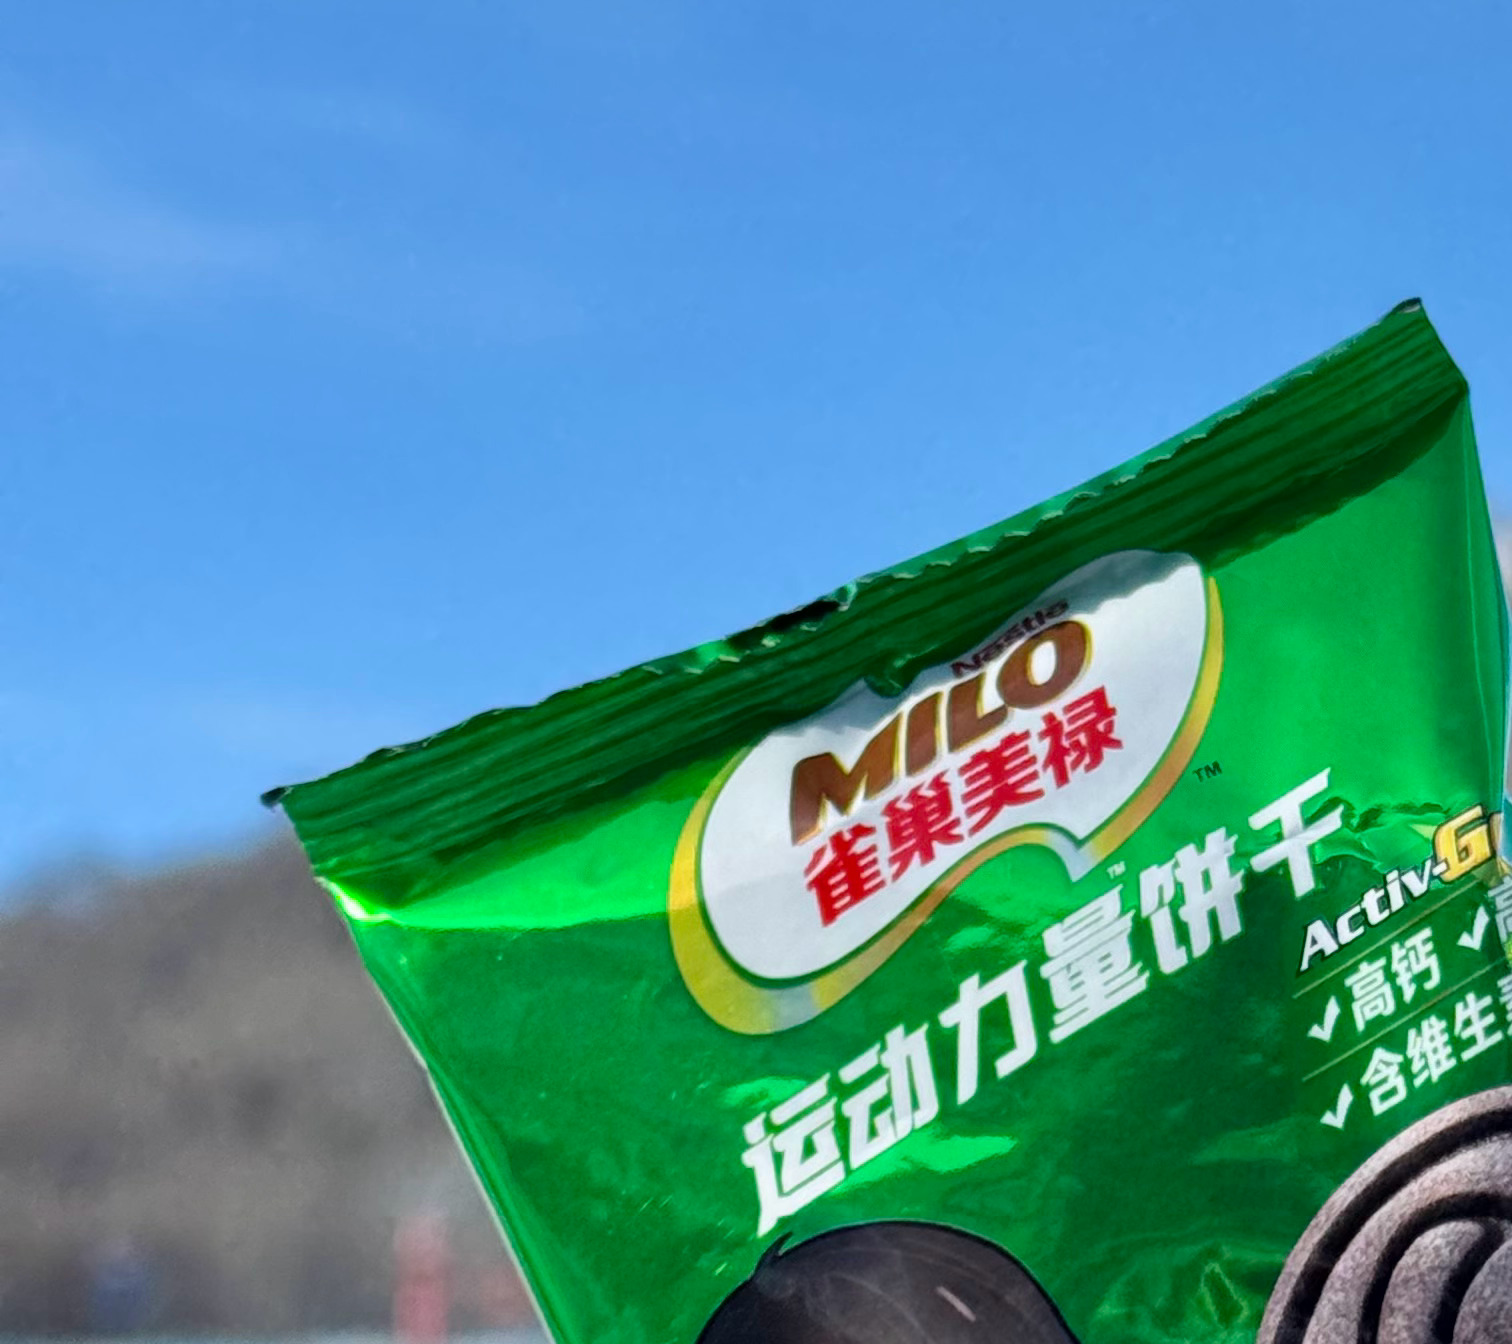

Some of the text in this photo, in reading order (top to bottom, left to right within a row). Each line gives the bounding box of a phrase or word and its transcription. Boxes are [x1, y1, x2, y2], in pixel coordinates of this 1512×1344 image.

[789, 620, 1089, 846] MILO
[805, 686, 1123, 927] 雀巢美禄
[1192, 760, 1223, 782] TM
[1298, 803, 1503, 973] Activ-G
[1344, 926, 1441, 1032] 高钙
[741, 768, 1345, 1237] 运动力量饼干
